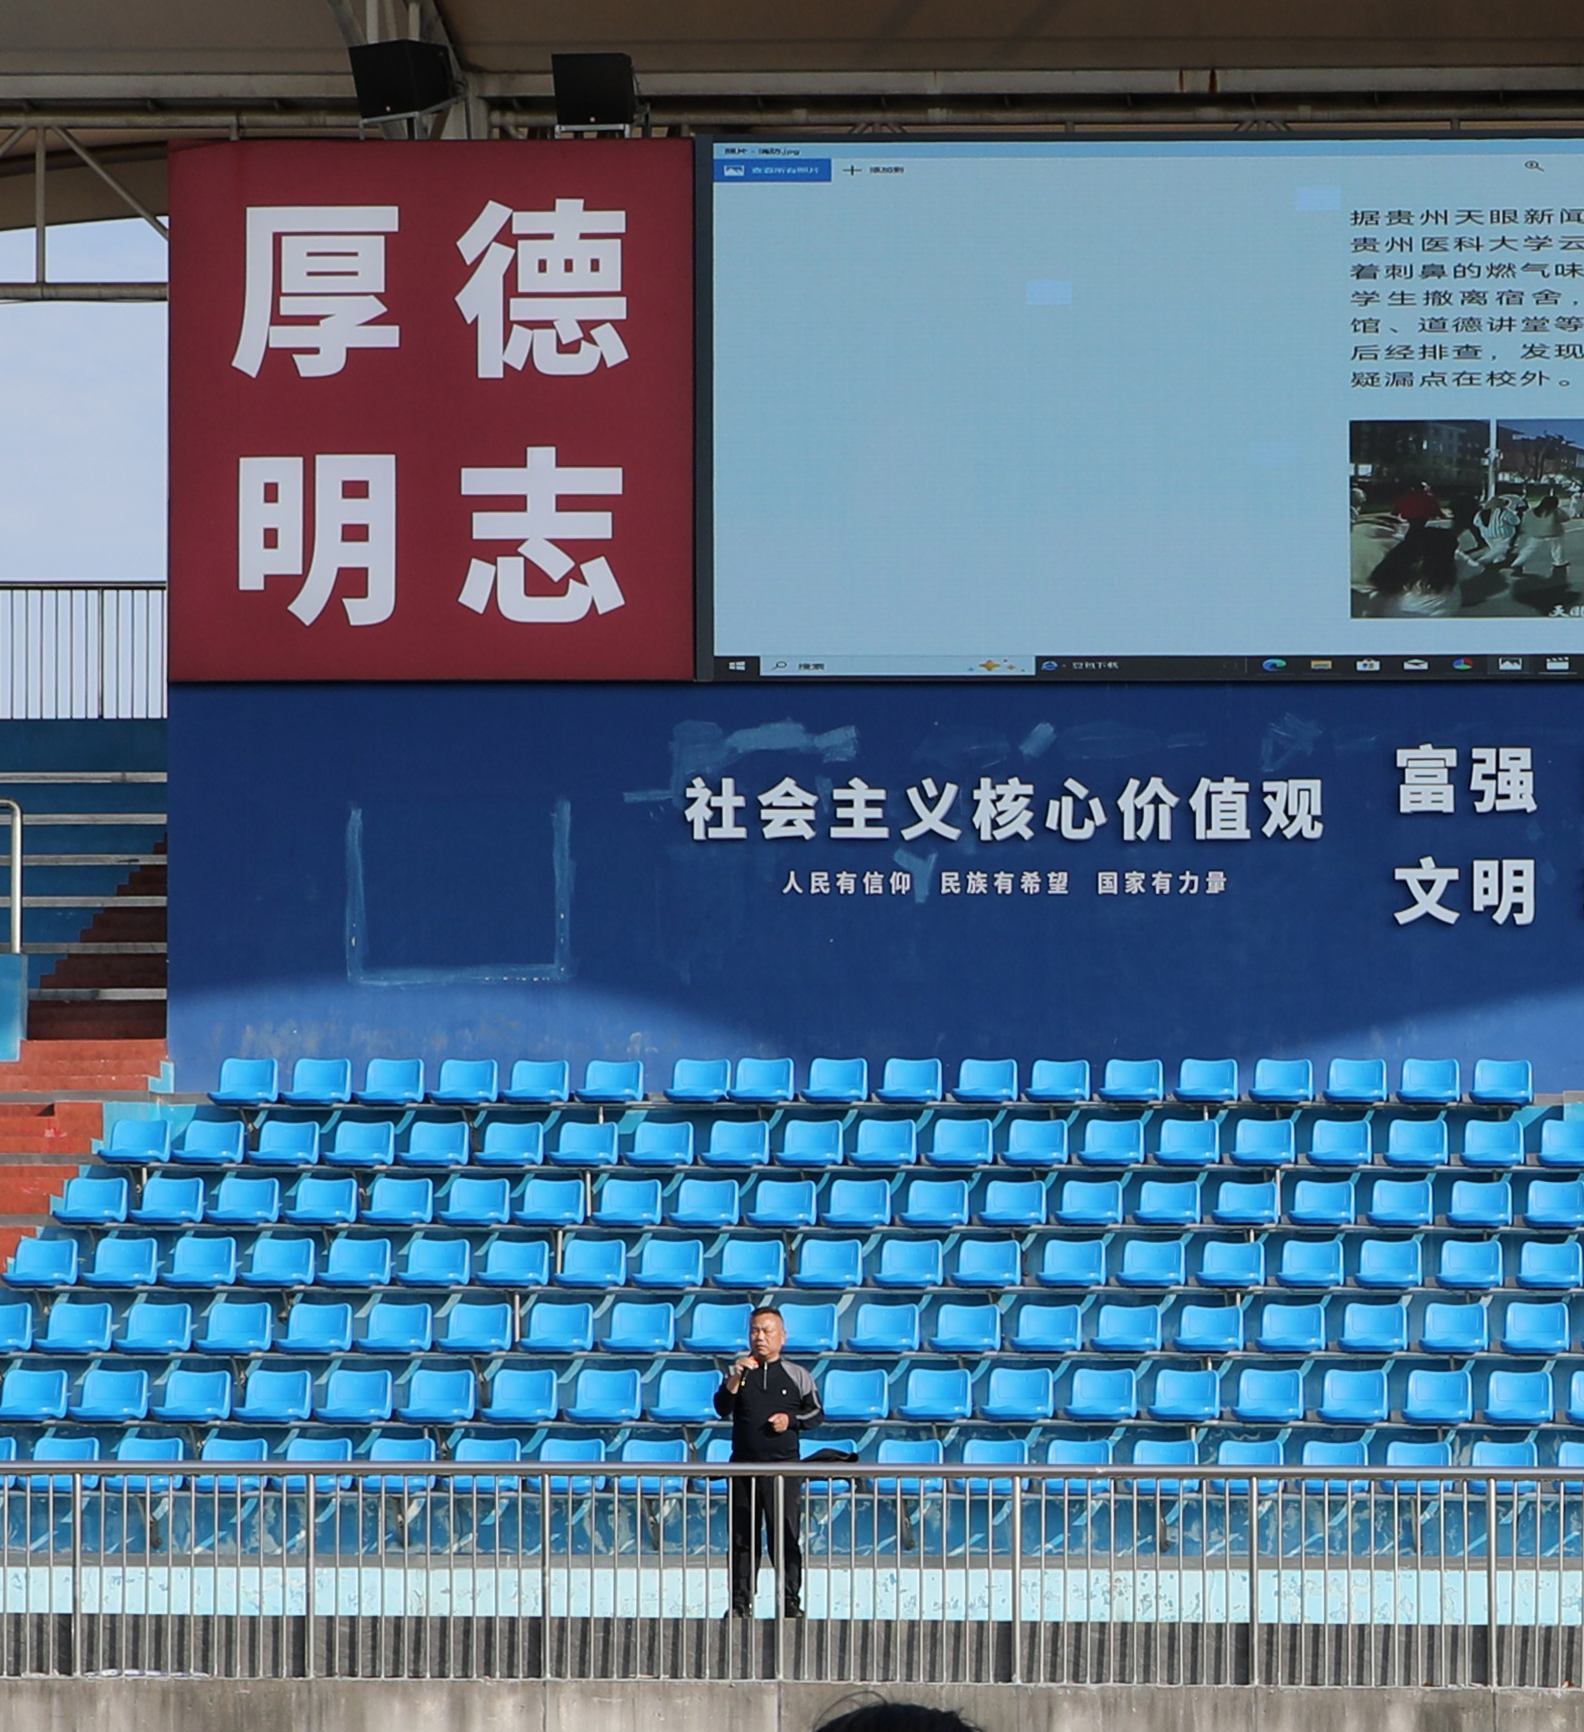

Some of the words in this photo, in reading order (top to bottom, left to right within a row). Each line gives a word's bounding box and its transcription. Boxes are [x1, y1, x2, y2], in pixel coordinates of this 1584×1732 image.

[232, 199, 628, 377] 厚德
[1350, 370, 1572, 388] 疑漏点在校外。
[239, 447, 624, 625] 明志
[685, 777, 1324, 840] 社会主义核心价值观
[1397, 744, 1536, 812] 富强
[782, 870, 911, 895] 人民有信仰
[940, 870, 1069, 895] 民族有希望
[1097, 870, 1227, 895] 国家有力量
[1395, 857, 1534, 924] 文明
